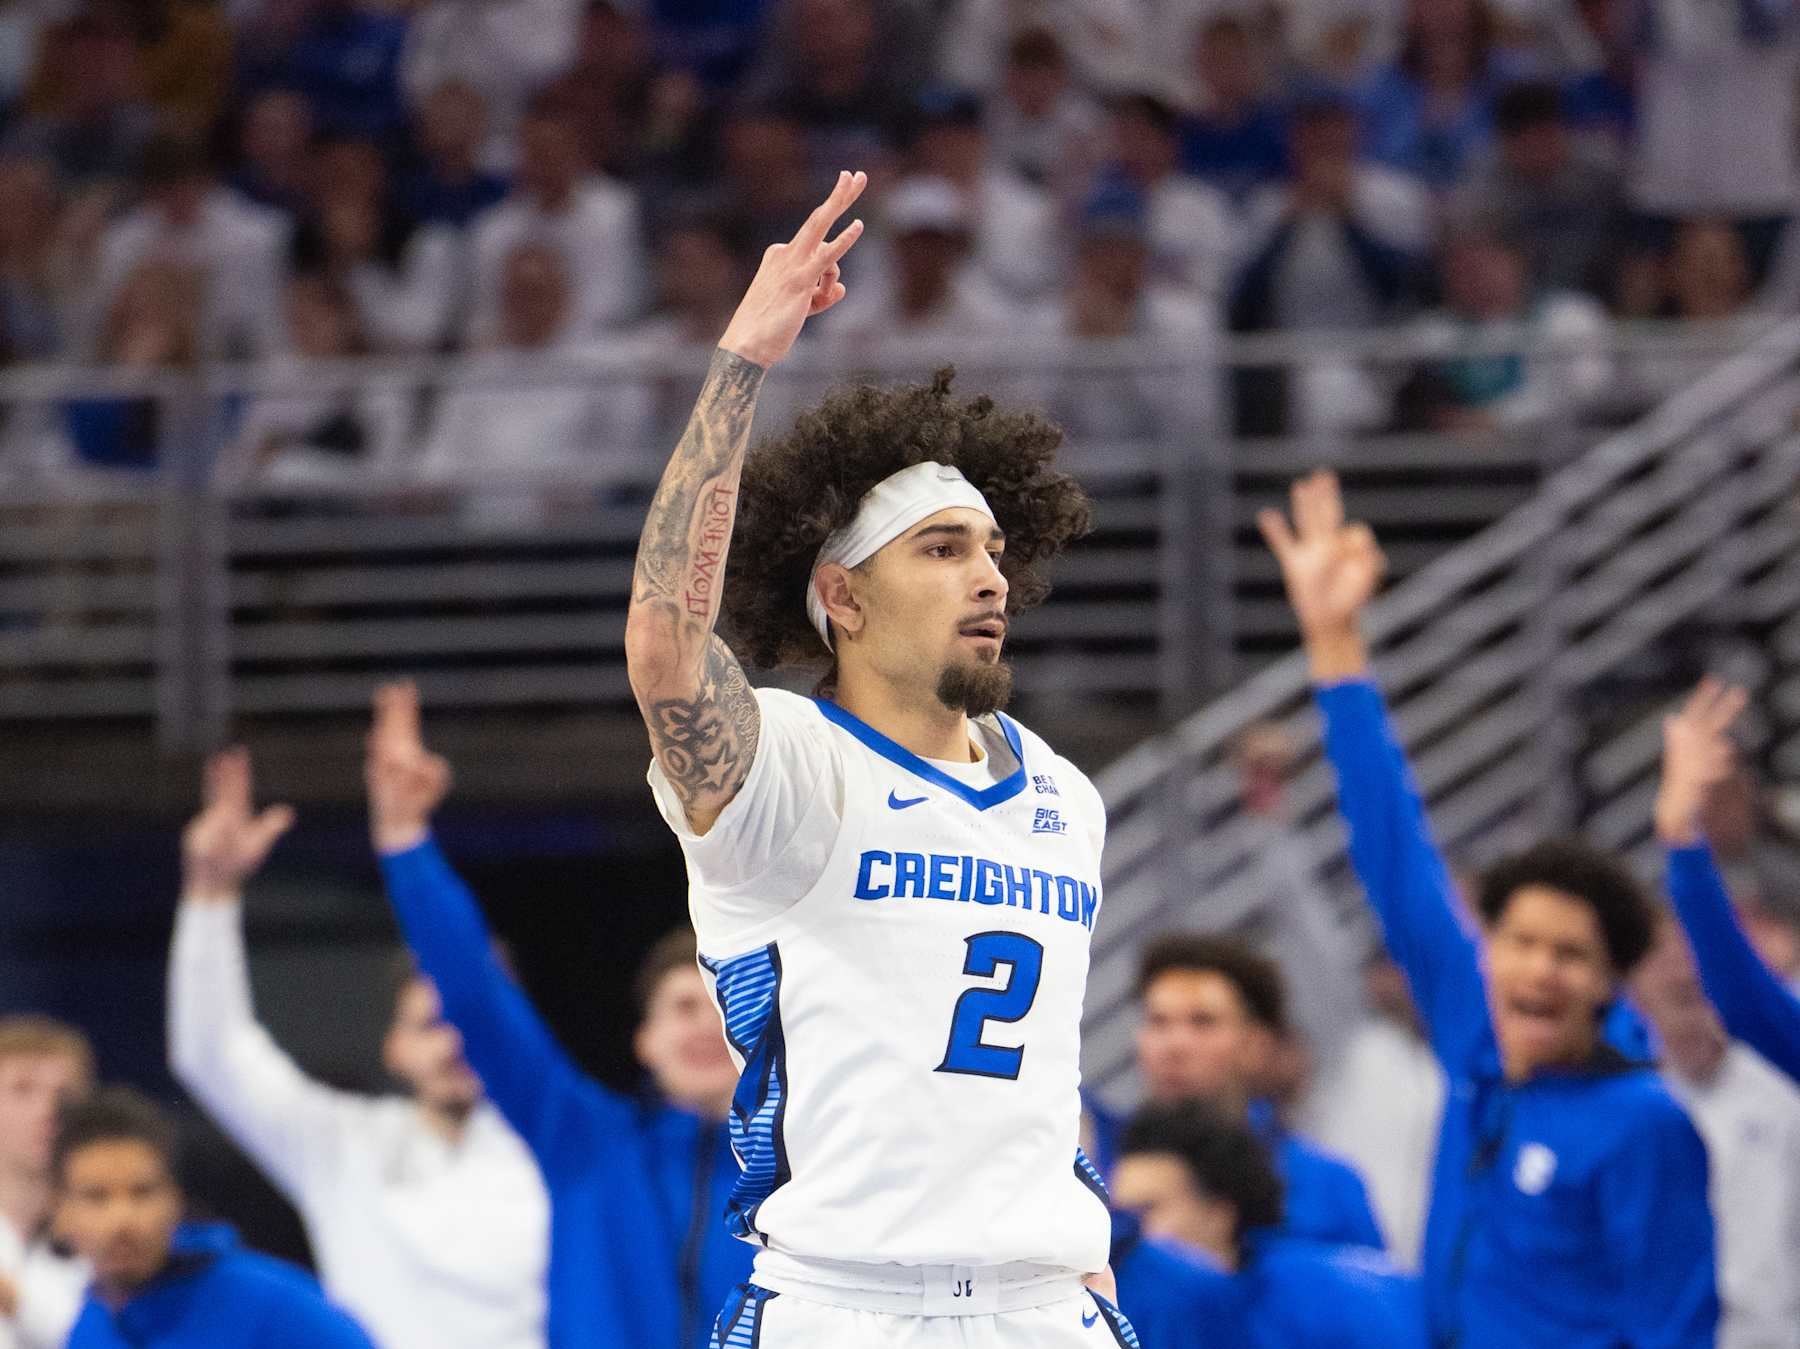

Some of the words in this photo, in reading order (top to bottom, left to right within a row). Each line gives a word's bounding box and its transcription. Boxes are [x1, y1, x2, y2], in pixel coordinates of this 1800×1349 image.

[1033, 819, 1068, 832] EAST
[1035, 808, 1059, 821] BIG
[853, 850, 1097, 932] CREIGHTON
[933, 930, 1045, 1081] 2
